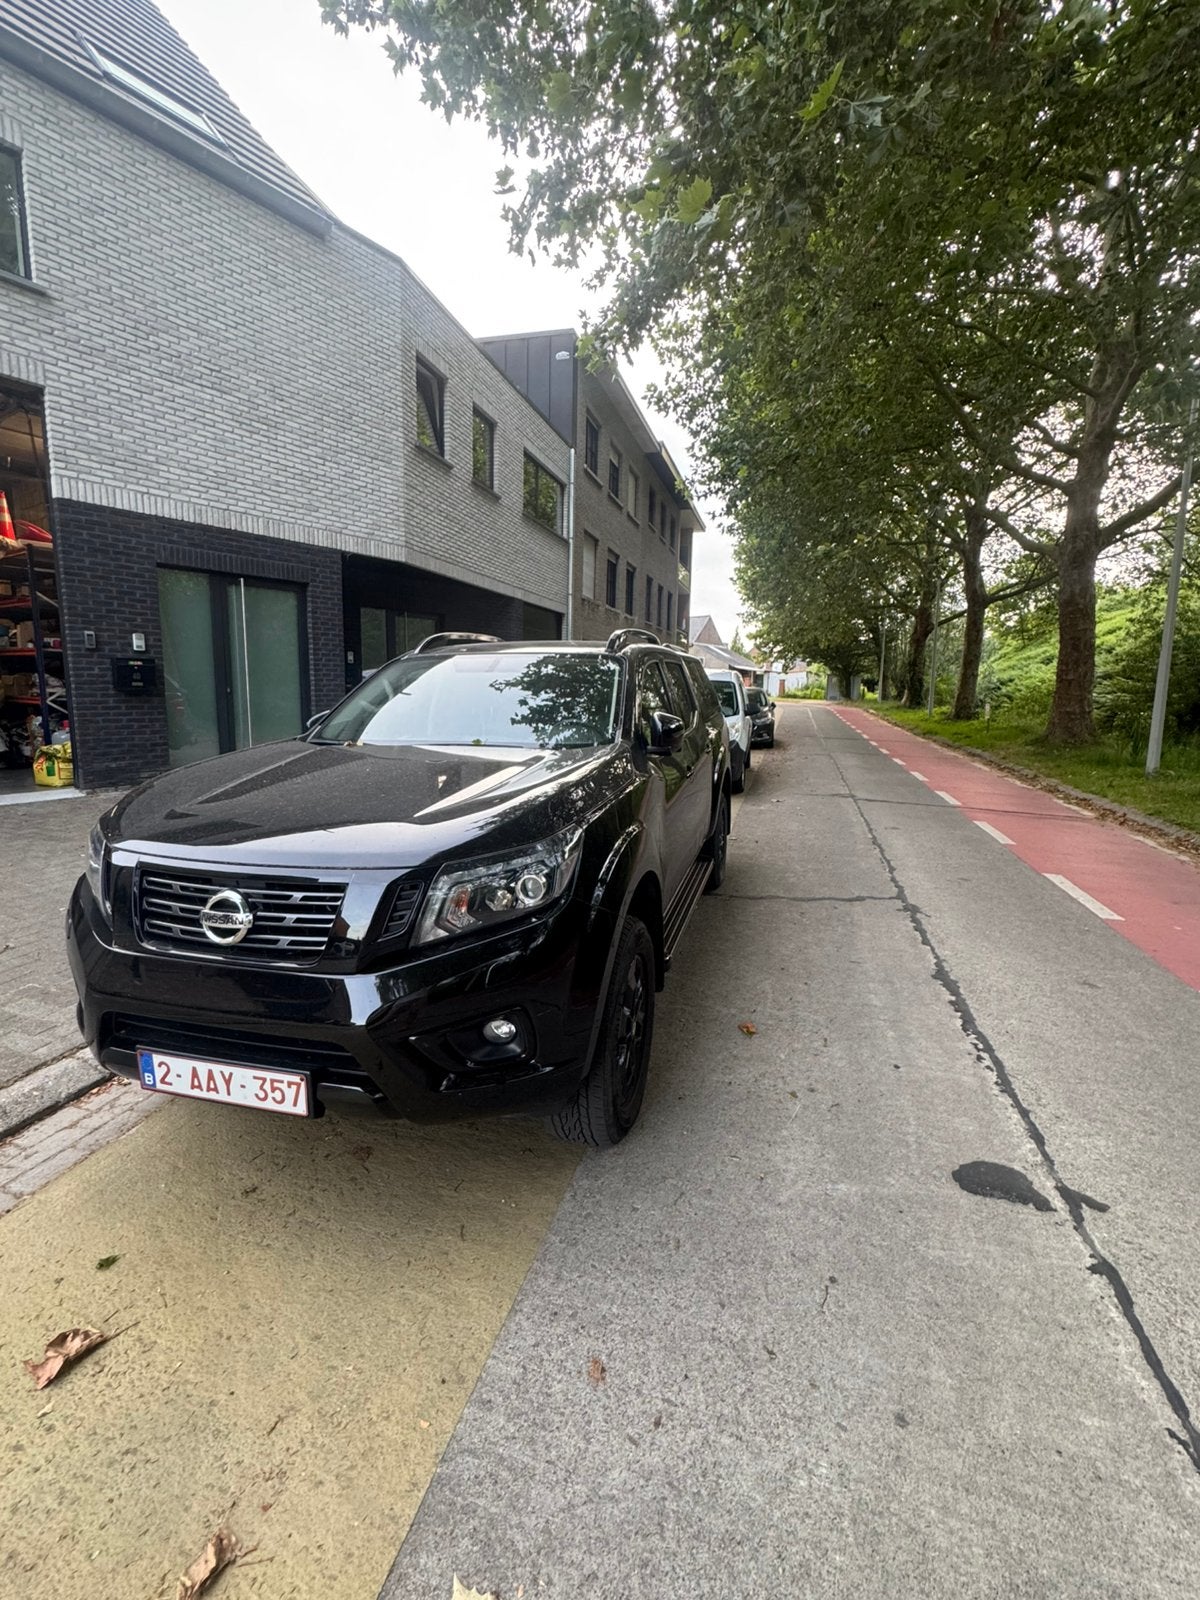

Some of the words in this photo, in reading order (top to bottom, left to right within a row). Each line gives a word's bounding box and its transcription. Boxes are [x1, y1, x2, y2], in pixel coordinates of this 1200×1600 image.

[202, 912, 244, 926] NISSAN
[144, 1072, 154, 1085] B
[157, 1061, 302, 1107] 2-AAY-357
